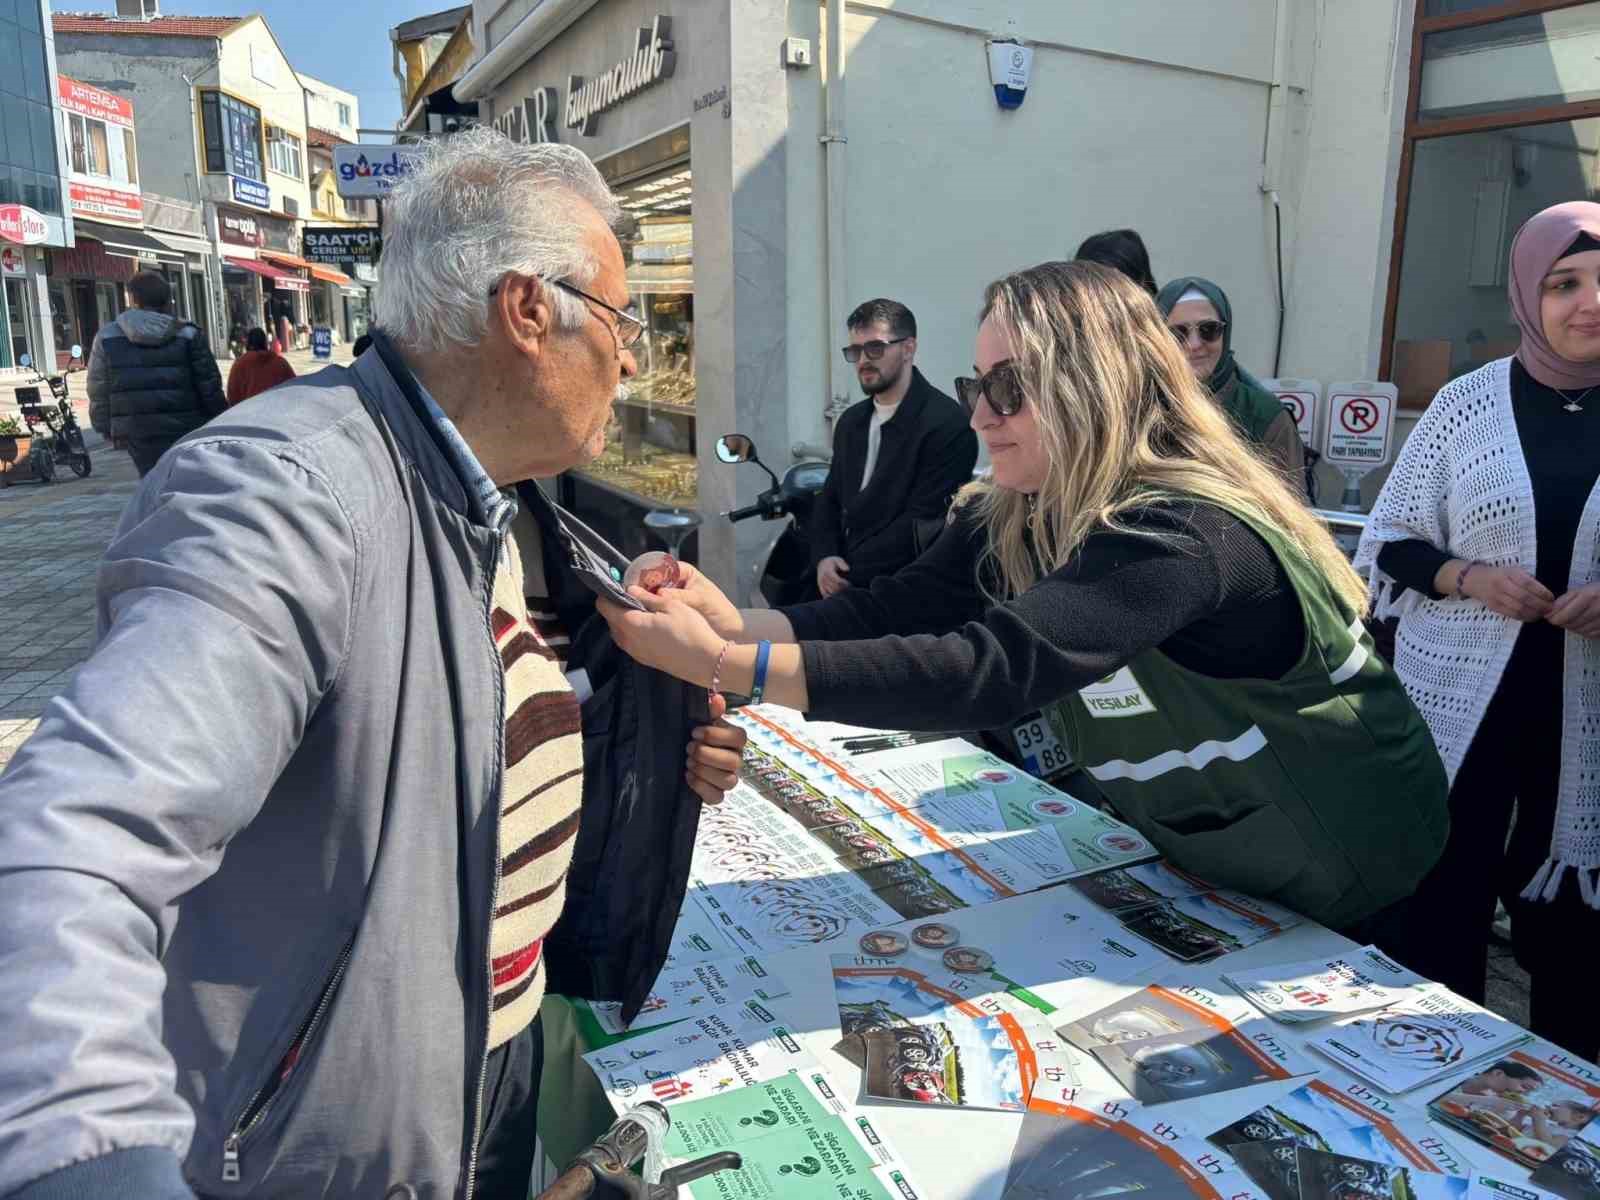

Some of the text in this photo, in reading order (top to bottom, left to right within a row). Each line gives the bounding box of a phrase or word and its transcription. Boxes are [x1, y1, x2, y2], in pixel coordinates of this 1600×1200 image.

[315, 330, 331, 345] WC
[1018, 723, 1044, 749] 39
[1042, 743, 1067, 770] 88
[732, 1038, 759, 1068] KUMAR
[806, 1127, 841, 1175] NE ZARARI
